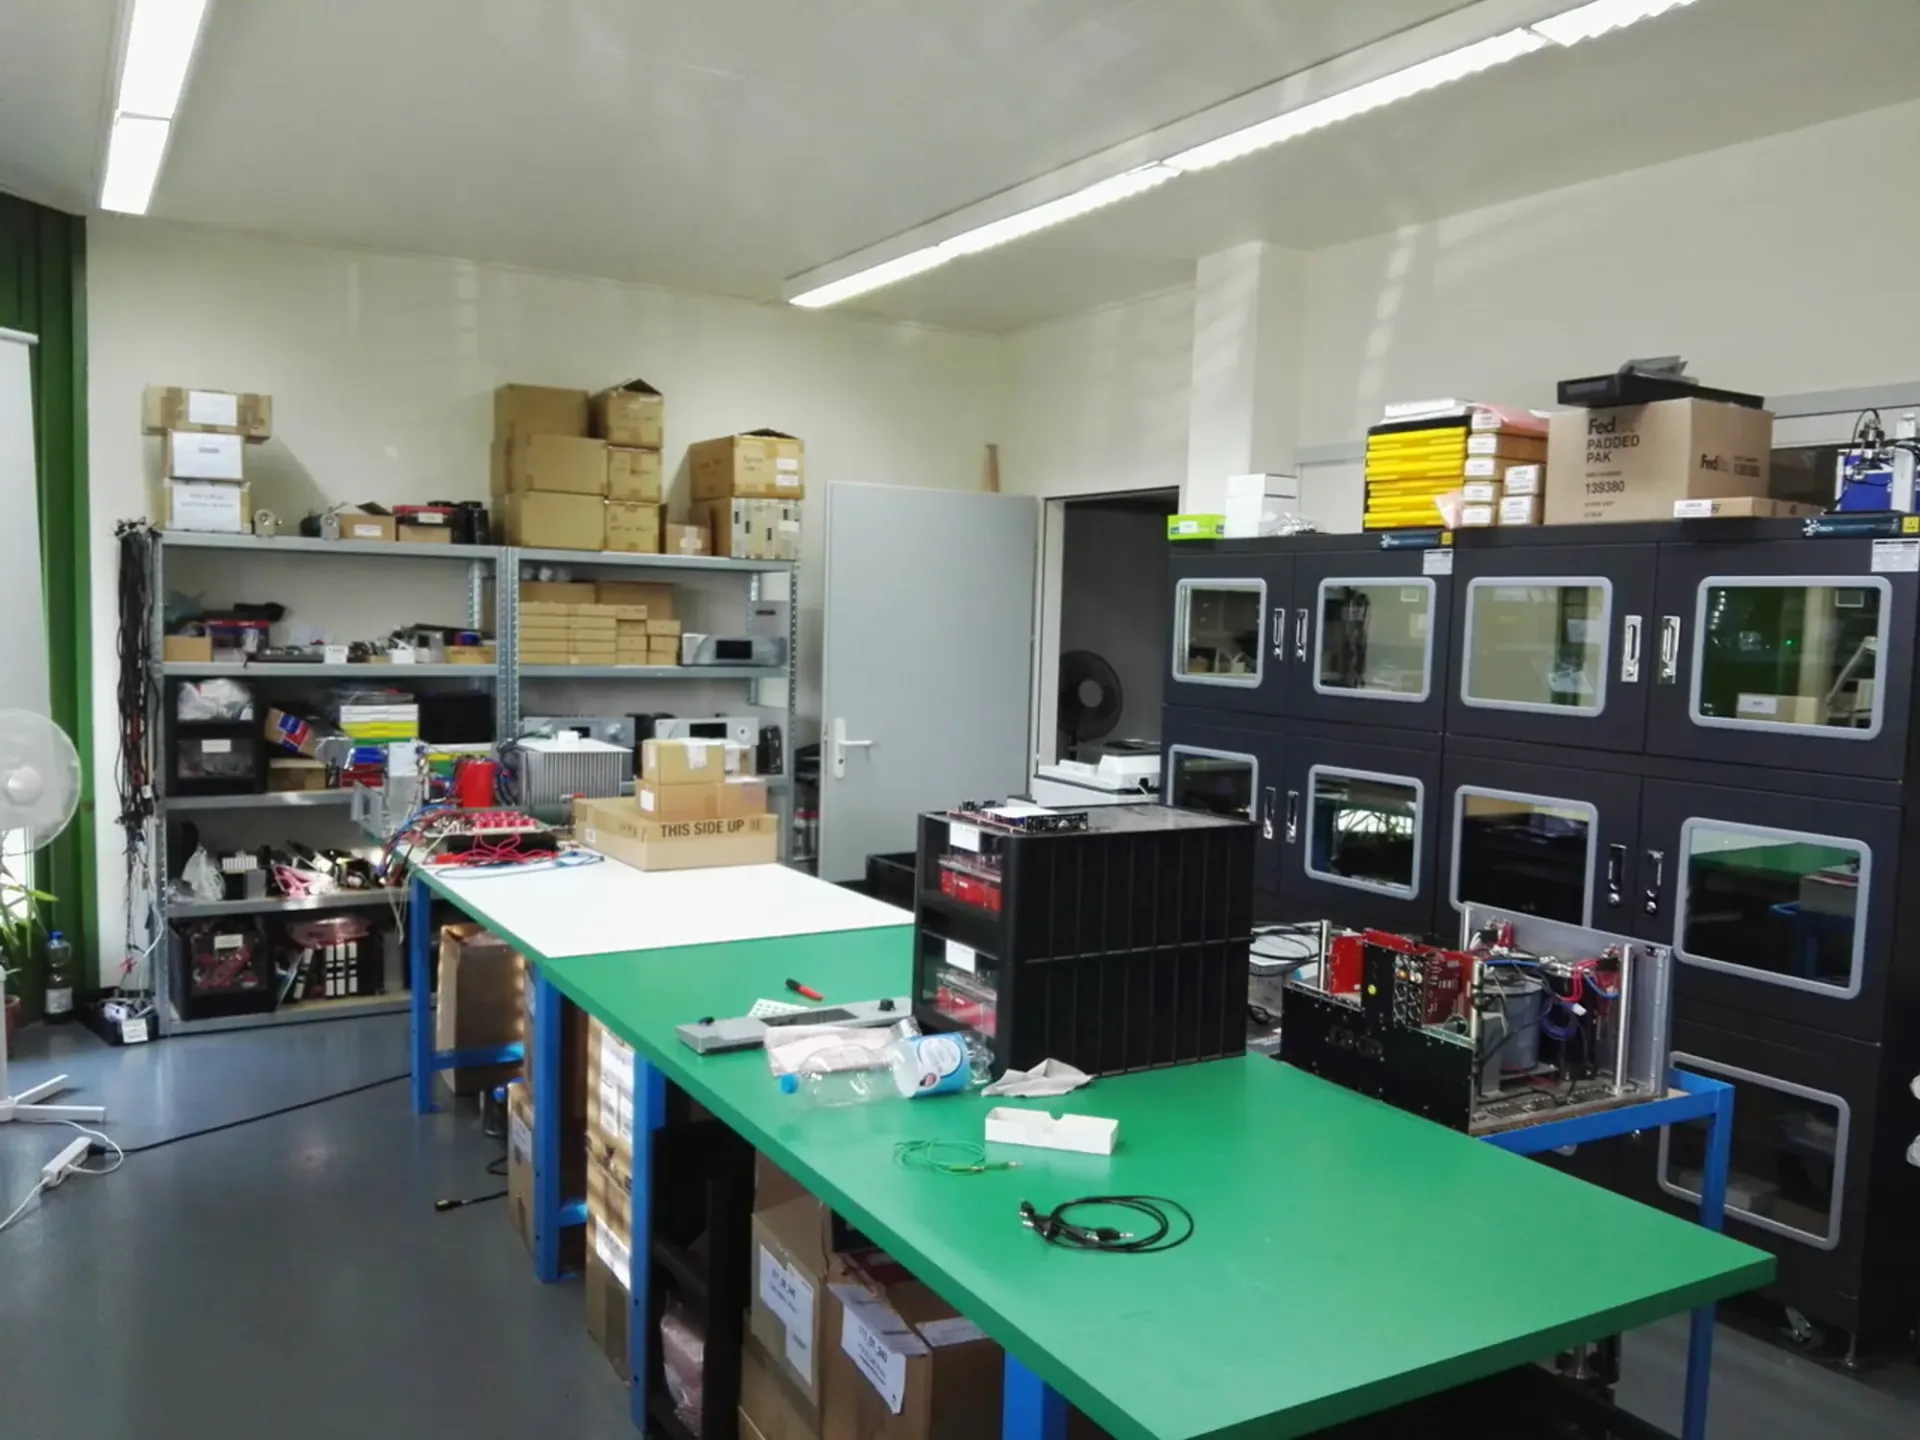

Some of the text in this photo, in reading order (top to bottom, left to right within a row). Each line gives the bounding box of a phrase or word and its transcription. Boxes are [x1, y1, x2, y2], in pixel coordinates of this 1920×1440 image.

[1587, 435, 1640, 450] PADDED
[1586, 451, 1612, 464] PAK
[660, 823, 690, 838] THIS
[694, 820, 724, 836] SIDE
[728, 819, 745, 833] UP
